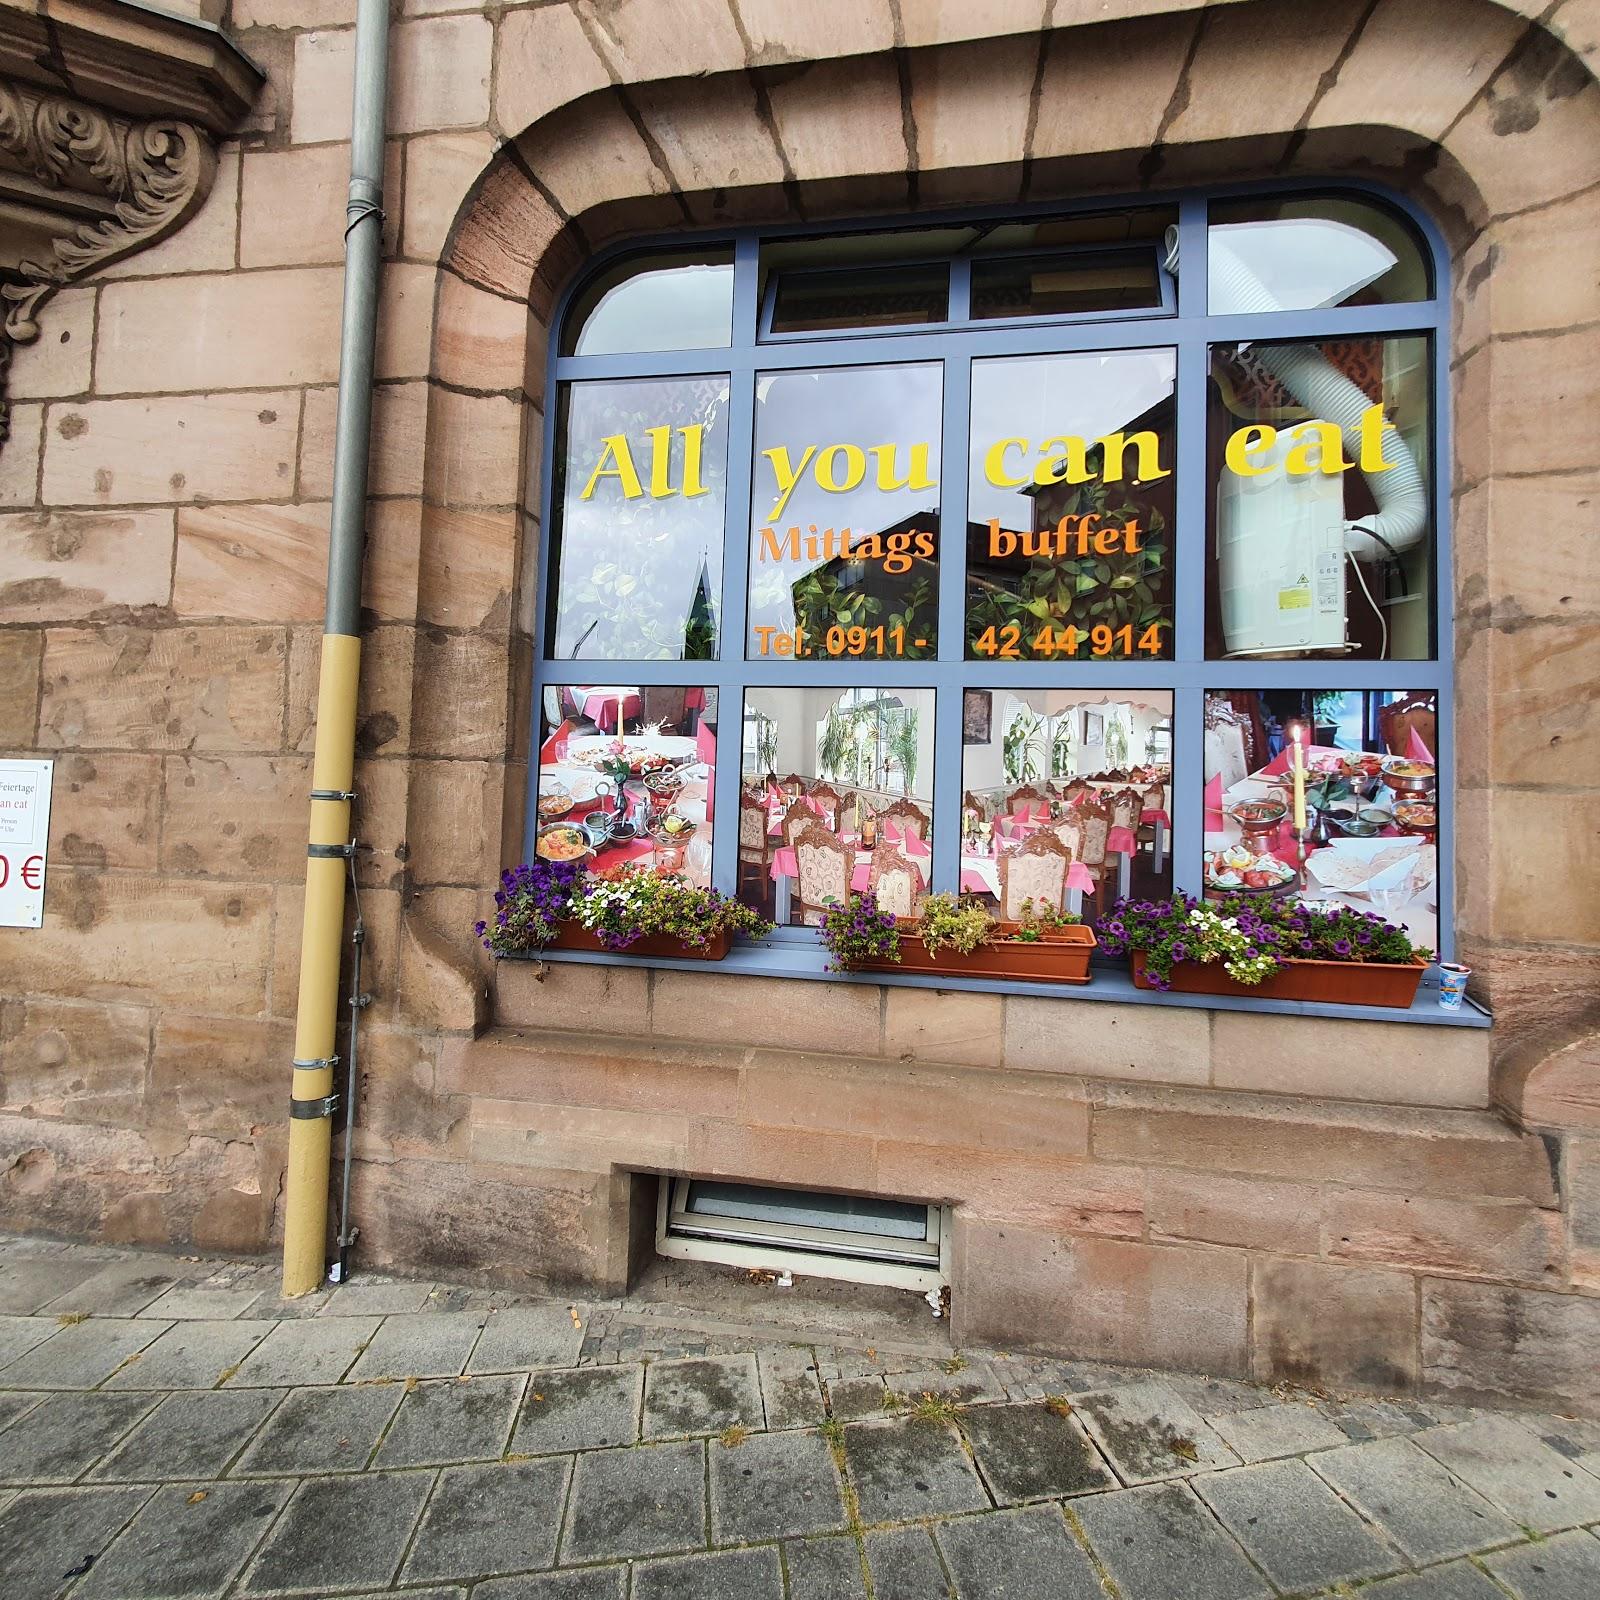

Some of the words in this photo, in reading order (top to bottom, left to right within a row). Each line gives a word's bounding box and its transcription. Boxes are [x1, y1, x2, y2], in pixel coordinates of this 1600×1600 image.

[579, 423, 711, 500] All
[762, 442, 938, 522] you
[984, 429, 1171, 488] can
[1225, 402, 1398, 476] eat
[758, 524, 935, 574] Mittags
[985, 513, 1142, 558] buffet
[754, 626, 812, 656] Tel.
[976, 626, 1020, 656] 42
[1032, 625, 1078, 656] 44
[1091, 624, 1163, 656] 914
[14, 800, 27, 809] eat
[21, 855, 43, 890] €
